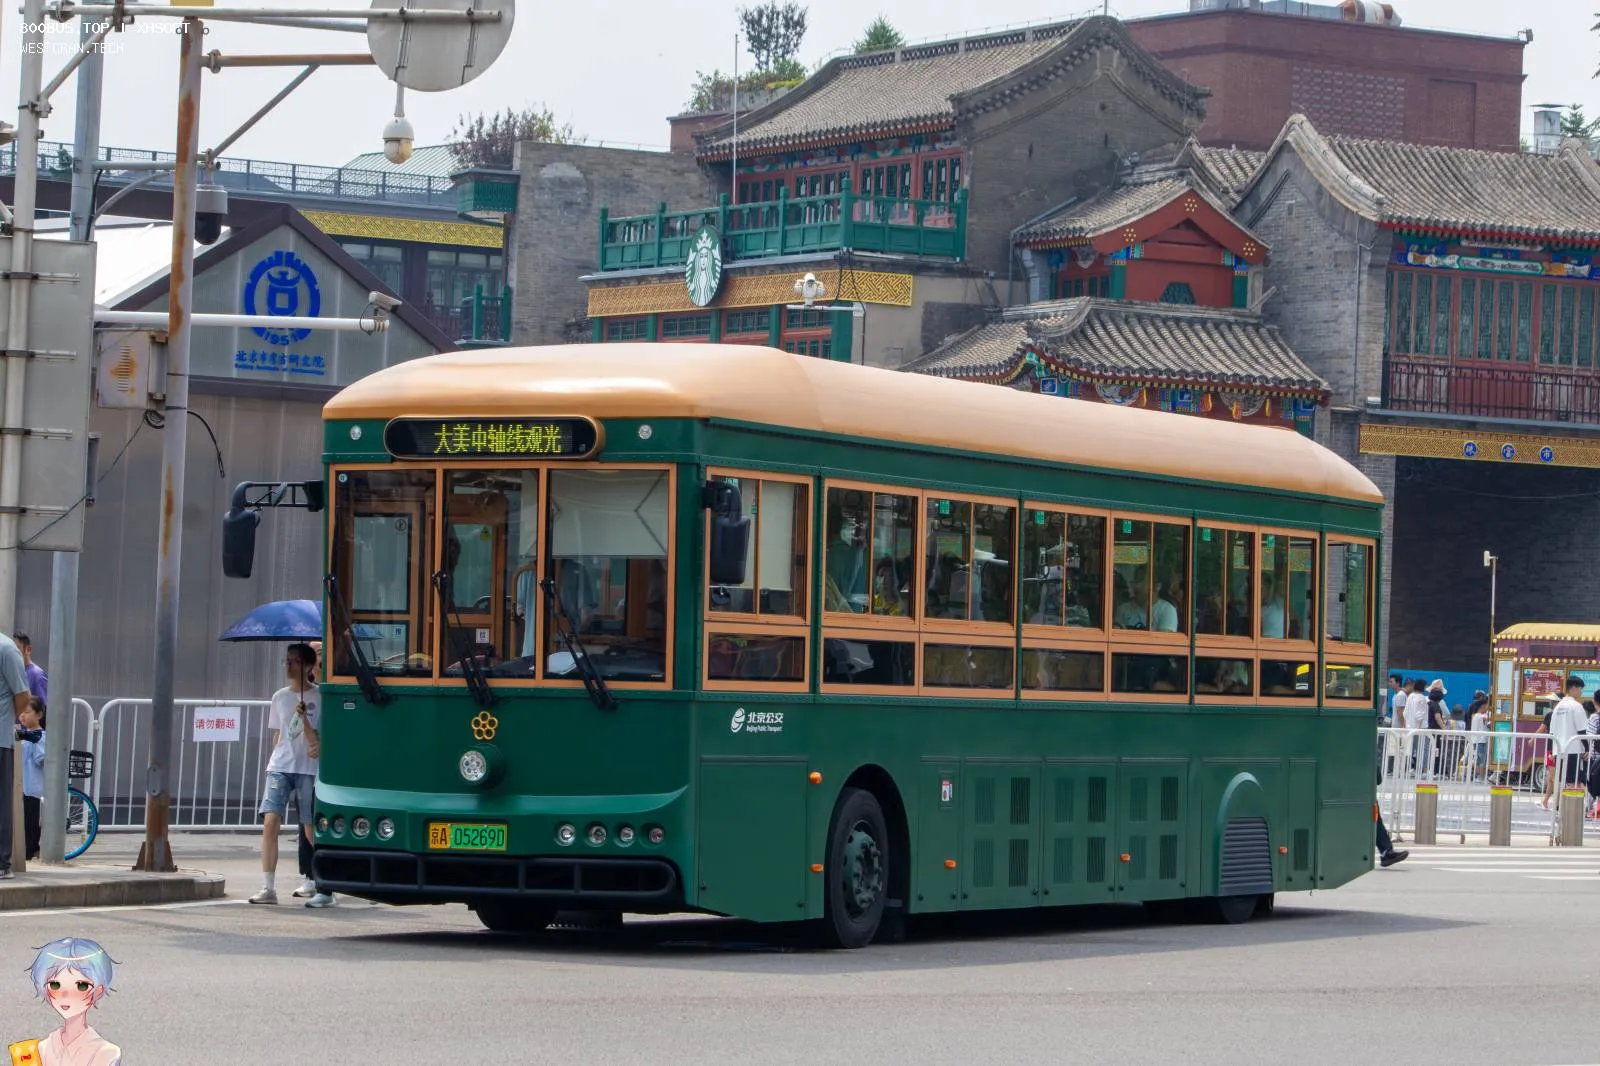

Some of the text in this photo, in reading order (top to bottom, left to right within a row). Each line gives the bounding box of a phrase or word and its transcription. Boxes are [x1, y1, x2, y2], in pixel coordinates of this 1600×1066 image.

[434, 423, 562, 453] 大美中轴线观光
[195, 718, 236, 730] 请勿翻越
[747, 712, 784, 724] 北京公交
